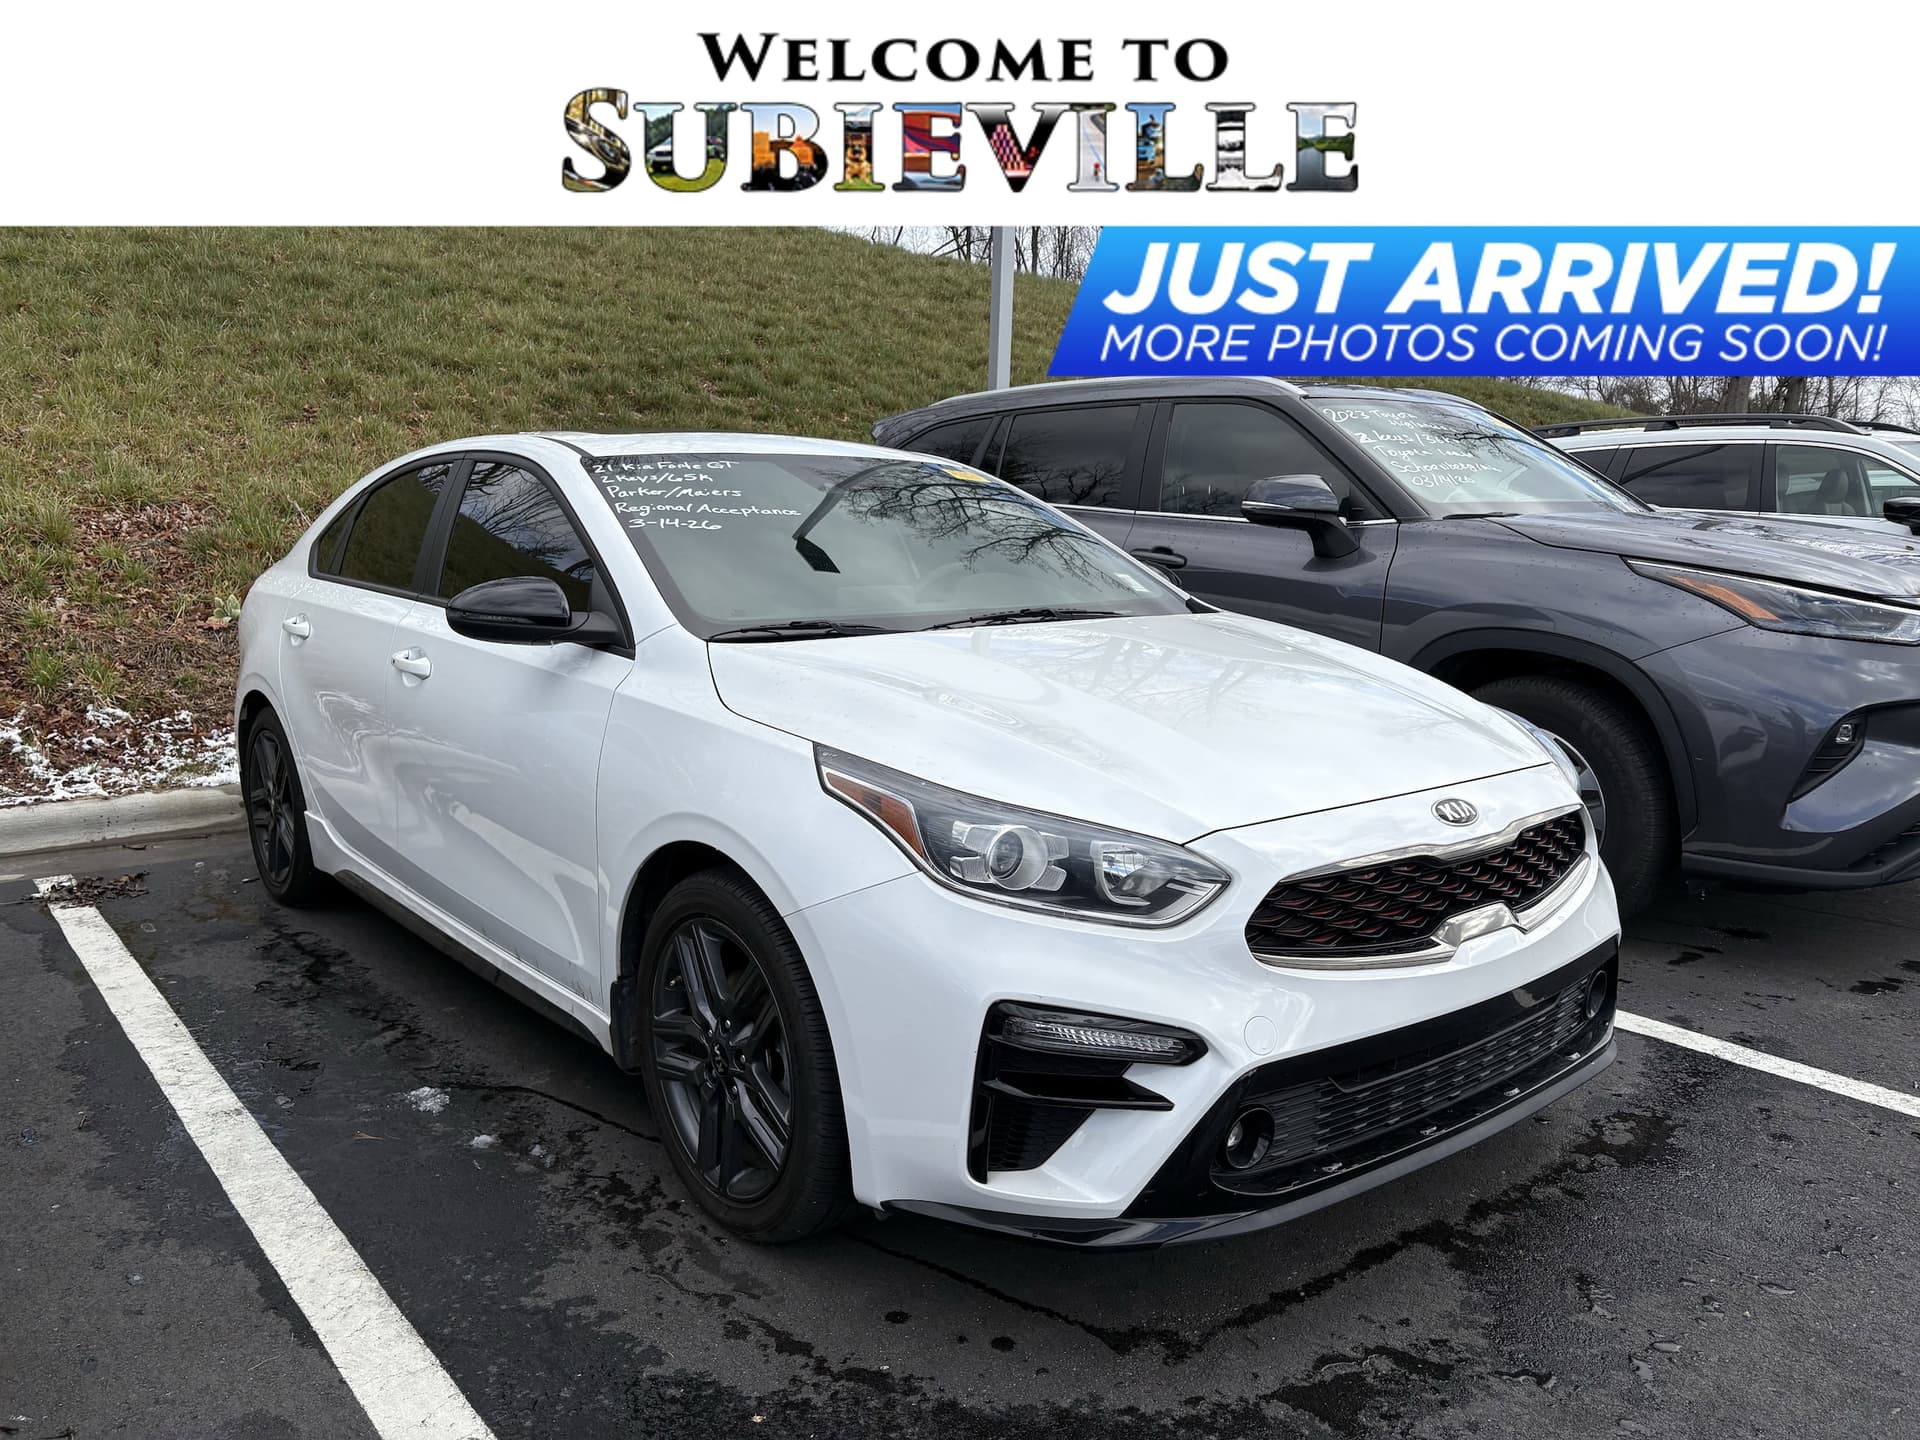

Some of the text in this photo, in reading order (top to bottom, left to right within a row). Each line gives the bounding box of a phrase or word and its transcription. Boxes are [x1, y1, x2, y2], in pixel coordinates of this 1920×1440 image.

[1322, 408, 1370, 423] 2023
[592, 464, 613, 474] 21
[622, 463, 654, 471] Kia
[707, 461, 740, 470] GT
[600, 475, 616, 484] 2
[615, 502, 693, 517] Regional
[629, 518, 722, 530] 3-14-26
[1437, 800, 1476, 821] KIA
